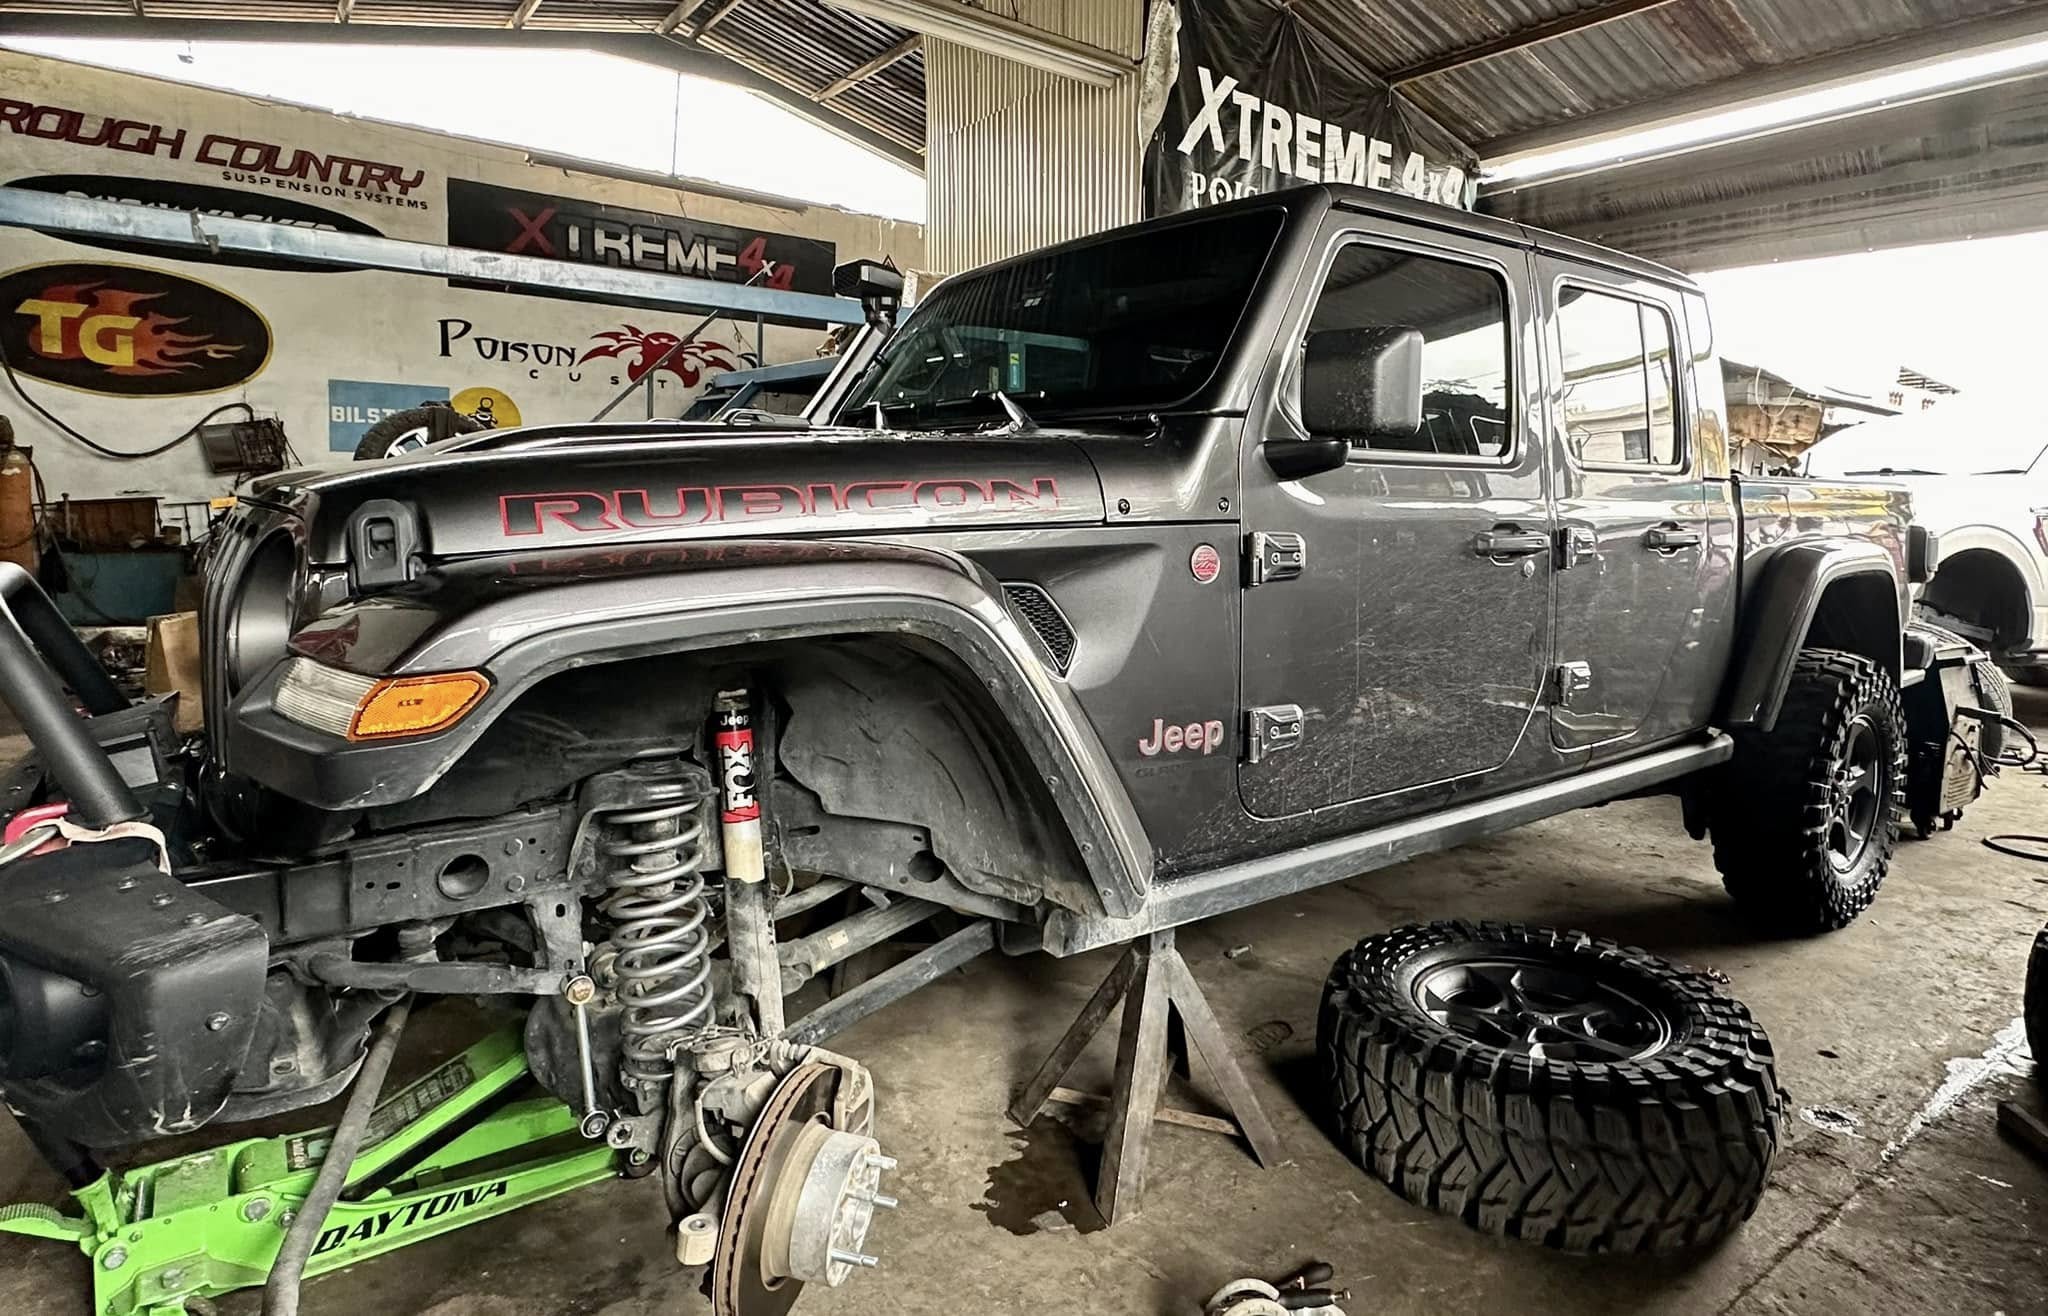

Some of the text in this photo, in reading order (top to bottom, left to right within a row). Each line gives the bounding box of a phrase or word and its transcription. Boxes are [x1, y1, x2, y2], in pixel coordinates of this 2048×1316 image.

[0, 97, 426, 196] ROUGH COUNTRY
[1177, 66, 1393, 193] XTREME
[222, 171, 429, 211] SUSPENSION SYSTEMS
[15, 298, 143, 367] TG
[500, 478, 1060, 536] RUBICON
[1137, 718, 1225, 758] Jeep
[724, 742, 755, 811] FOX
[310, 1180, 509, 1257] DAYTONA
